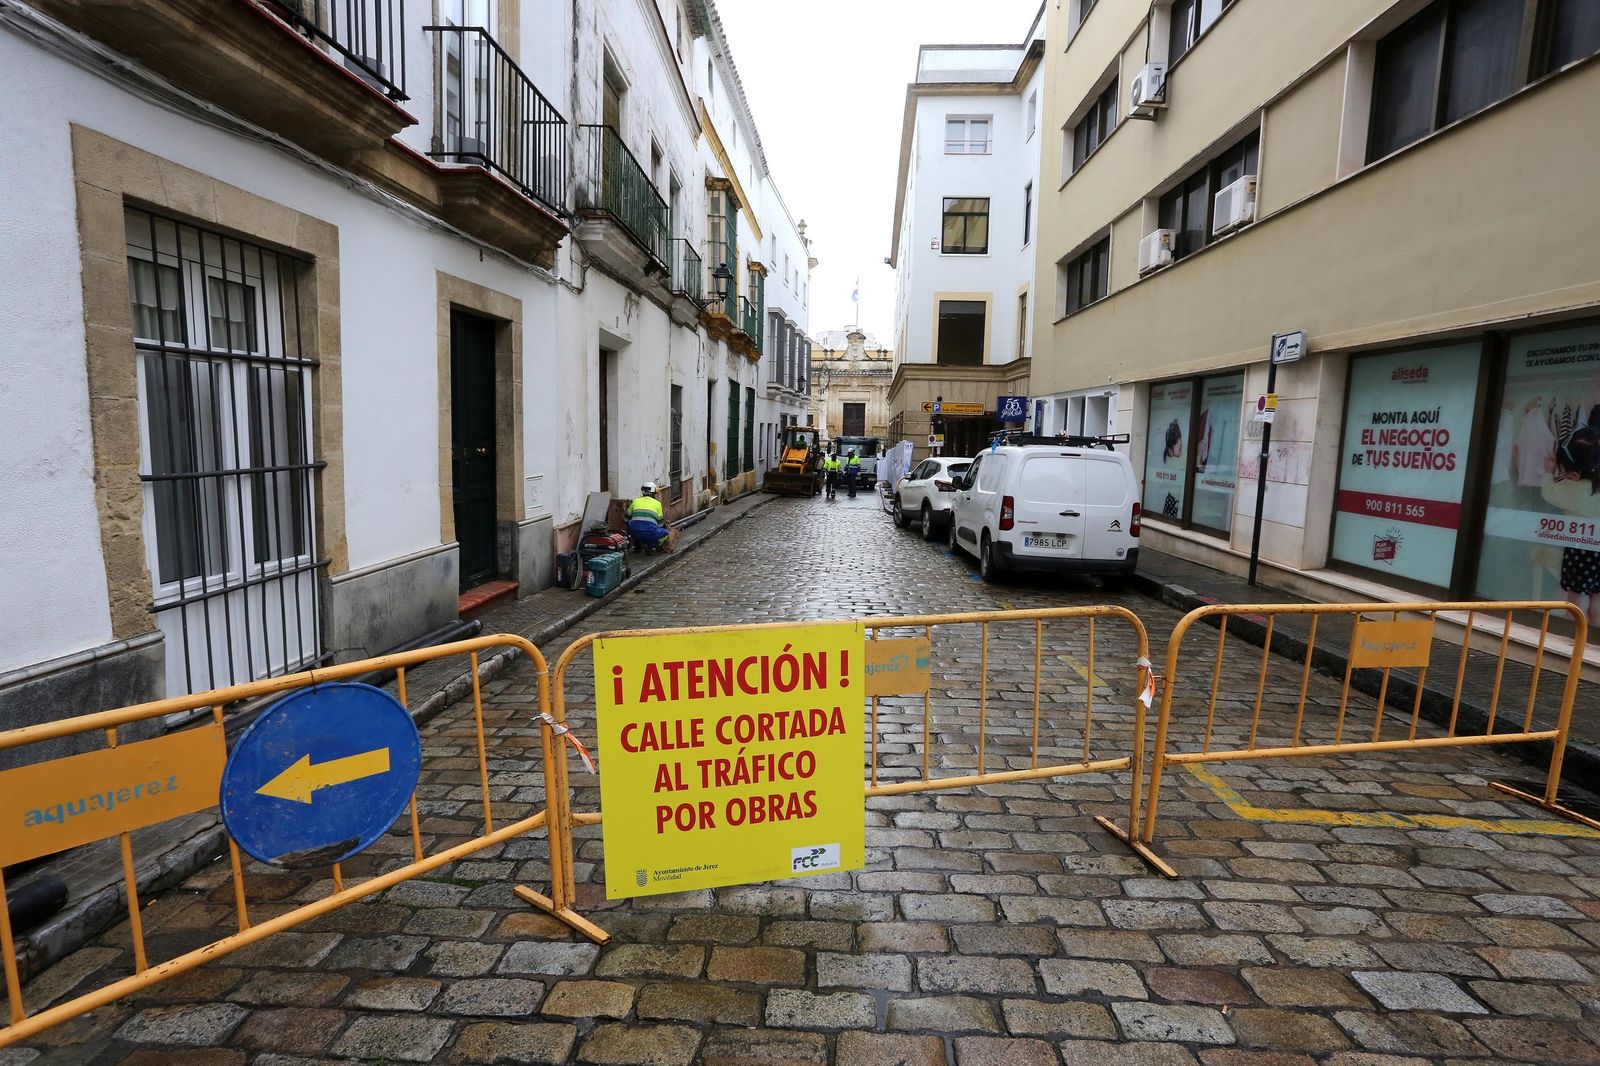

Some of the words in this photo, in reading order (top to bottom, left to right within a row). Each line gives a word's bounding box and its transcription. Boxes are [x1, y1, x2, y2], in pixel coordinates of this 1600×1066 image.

[1391, 364, 1429, 380] aliseda
[1005, 398, 1020, 410] 55
[1372, 411, 1408, 424] MONTA
[1410, 406, 1441, 424] AQUÍ
[1361, 428, 1376, 446] EL
[1379, 428, 1450, 447] NEGOCIO
[1352, 453, 1363, 465] DE
[1366, 450, 1390, 467] TUS
[1393, 447, 1456, 471] SUEÑOS
[1365, 499, 1382, 511] 900
[1385, 501, 1402, 514] 811
[1405, 504, 1426, 517] 565
[1540, 518, 1565, 532] 900
[1569, 521, 1595, 536] 811
[1029, 538, 1050, 547] 7985
[1051, 539, 1067, 548] LCP
[639, 643, 827, 703] ATENCIÓN
[621, 718, 704, 753] CALLE
[716, 707, 846, 745] CORTADA
[654, 762, 688, 793] AL
[697, 747, 815, 789] TRÁFICO
[24, 775, 179, 827] aquajerez
[656, 801, 716, 834] POR
[726, 790, 817, 827] OBRAS
[653, 866, 694, 875] Ayuntamiento
[793, 855, 819, 869] FCC
